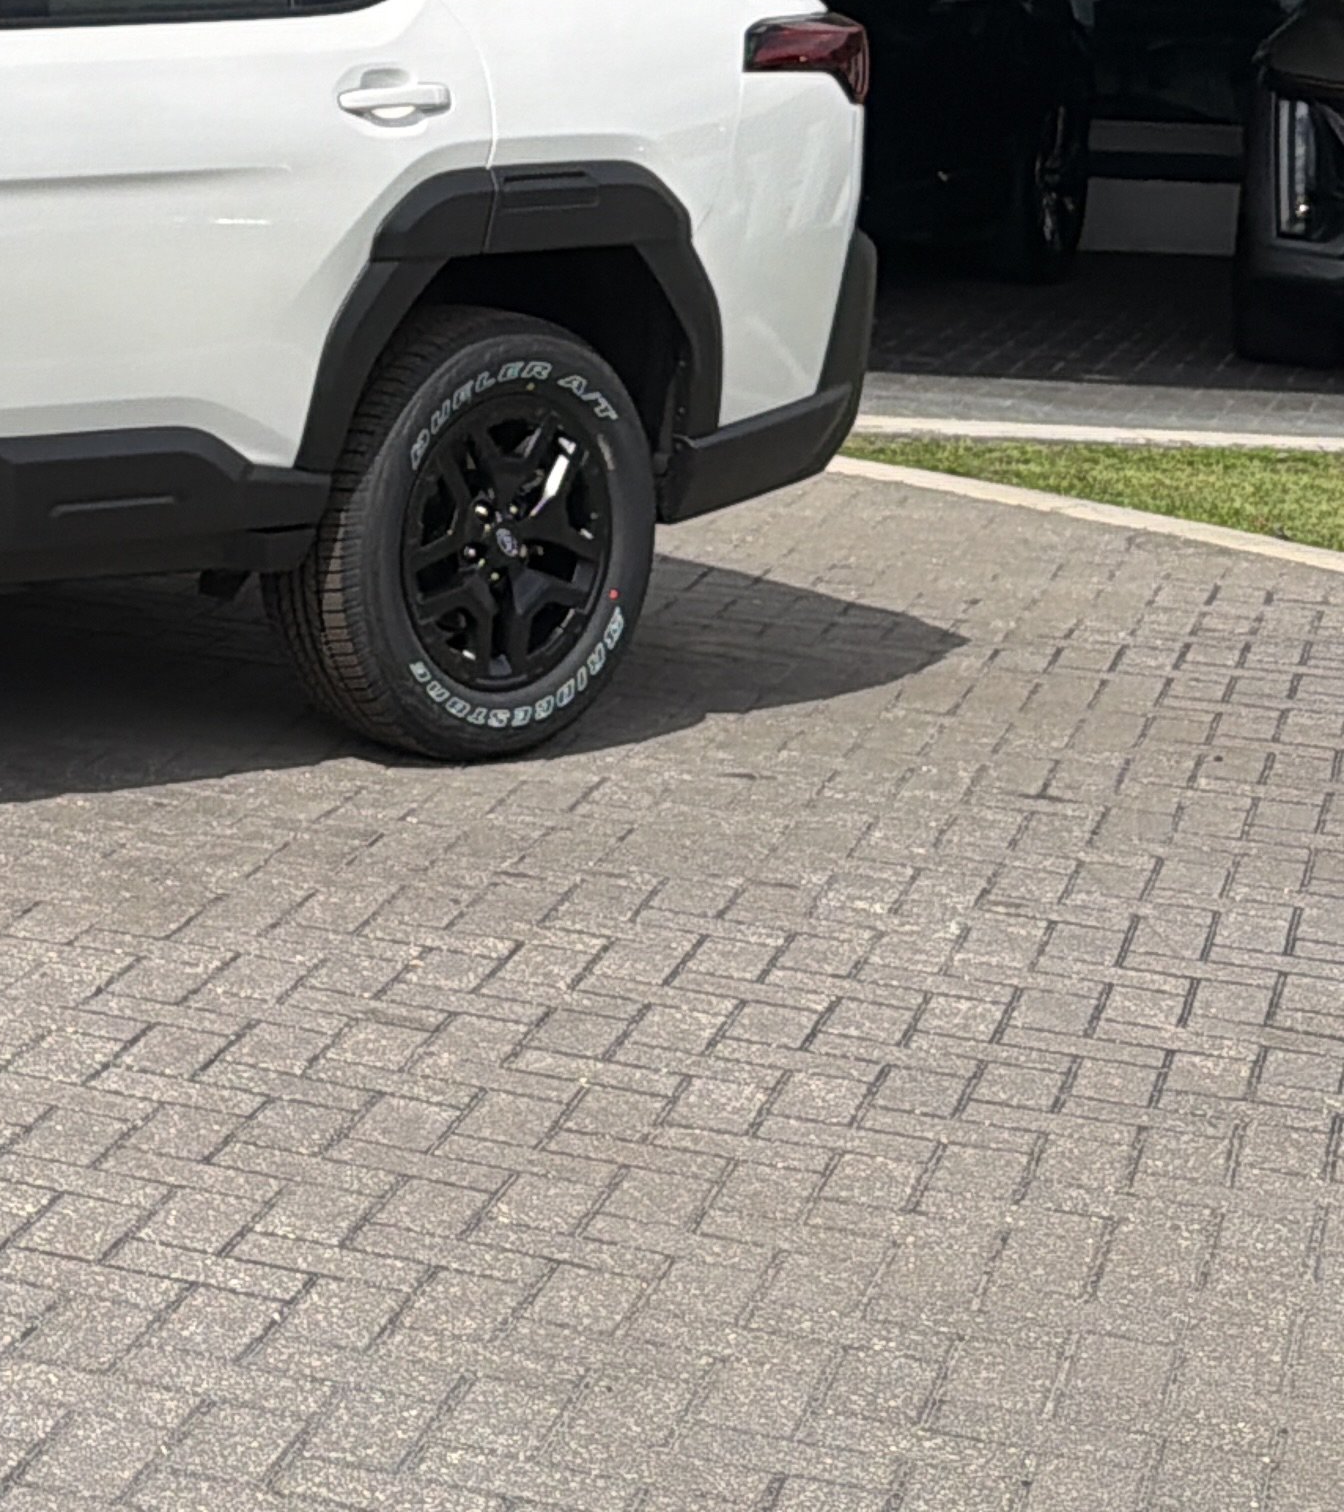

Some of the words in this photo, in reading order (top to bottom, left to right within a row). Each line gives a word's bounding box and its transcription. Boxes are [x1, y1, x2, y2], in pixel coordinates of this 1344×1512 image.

[412, 360, 552, 471] DUELER
[558, 374, 618, 422] A/T
[409, 606, 625, 728] BRIDGESTONE
